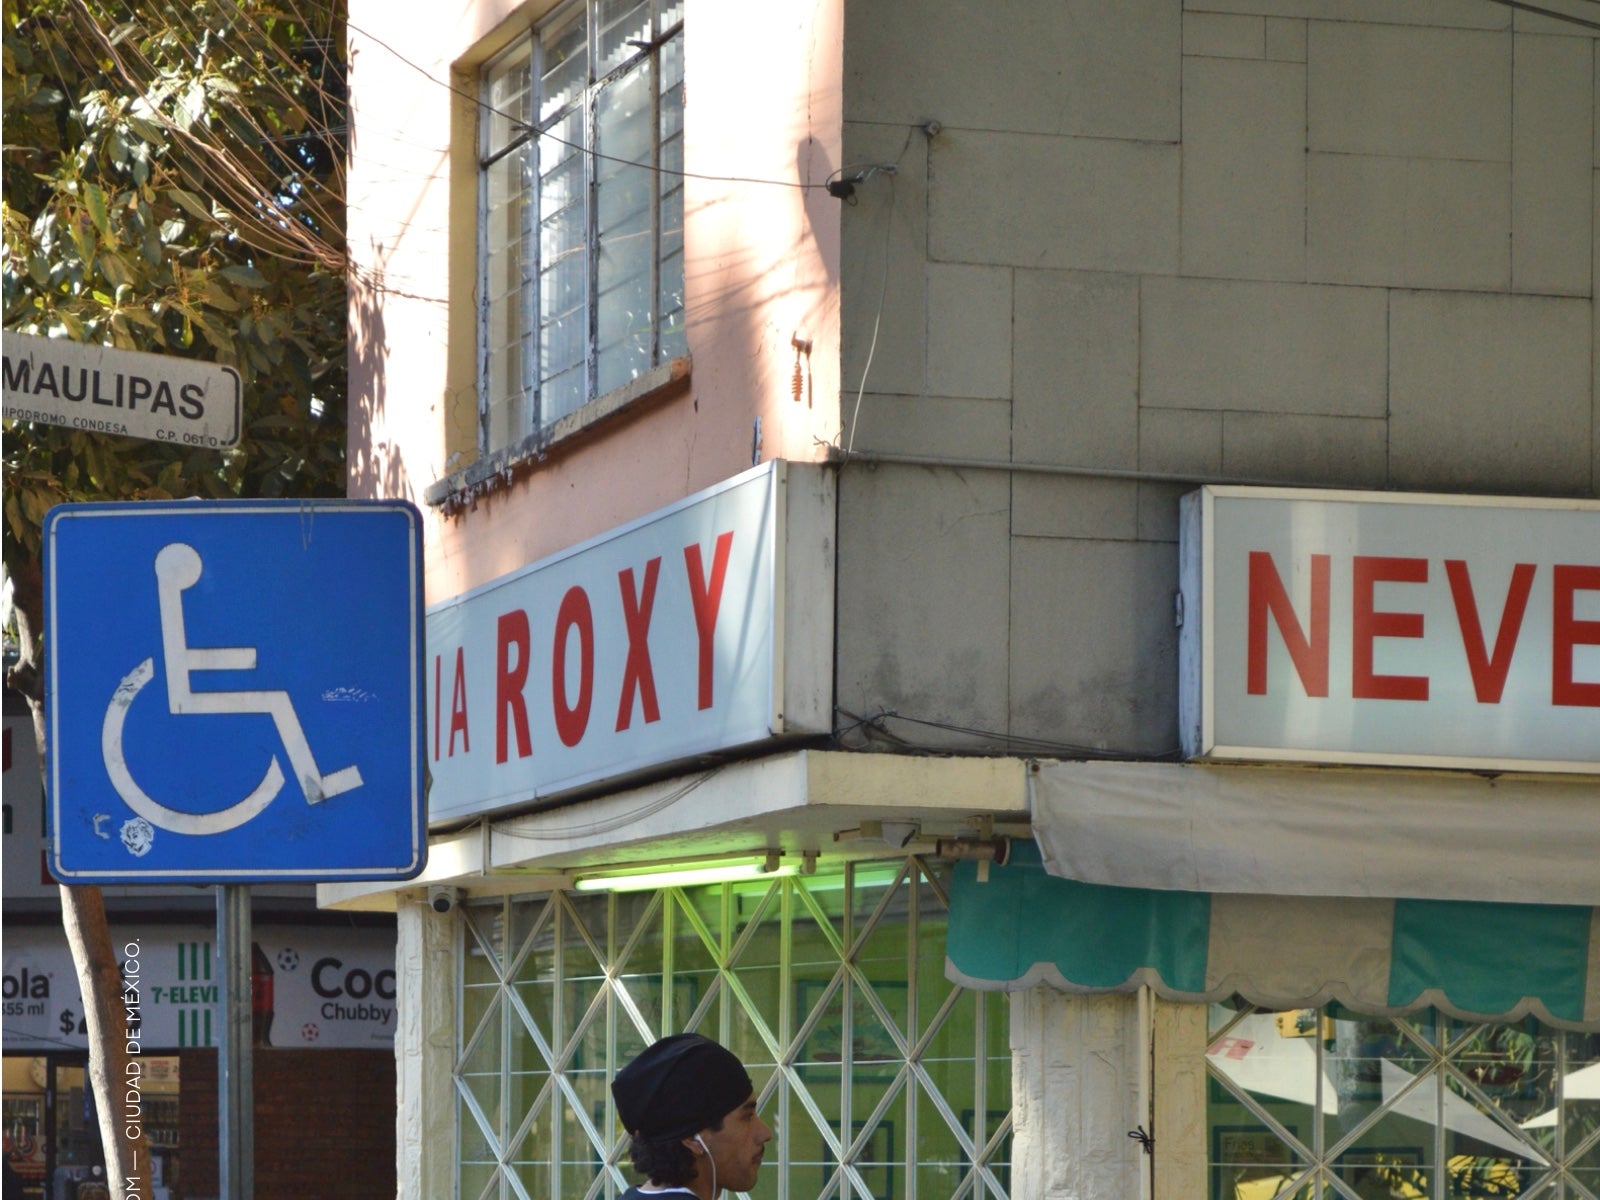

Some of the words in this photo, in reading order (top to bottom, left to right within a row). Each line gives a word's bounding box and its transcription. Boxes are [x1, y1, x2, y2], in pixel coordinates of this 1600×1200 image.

[2, 355, 204, 420] MAULIPAS
[72, 417, 129, 434] CONDESA
[155, 428, 178, 441] C.P.
[182, 432, 218, 447] 0610
[1247, 551, 1600, 707] NEVE
[496, 530, 734, 765] ROXY
[27, 1002, 45, 1016] ml
[321, 1002, 391, 1026] Chubby
